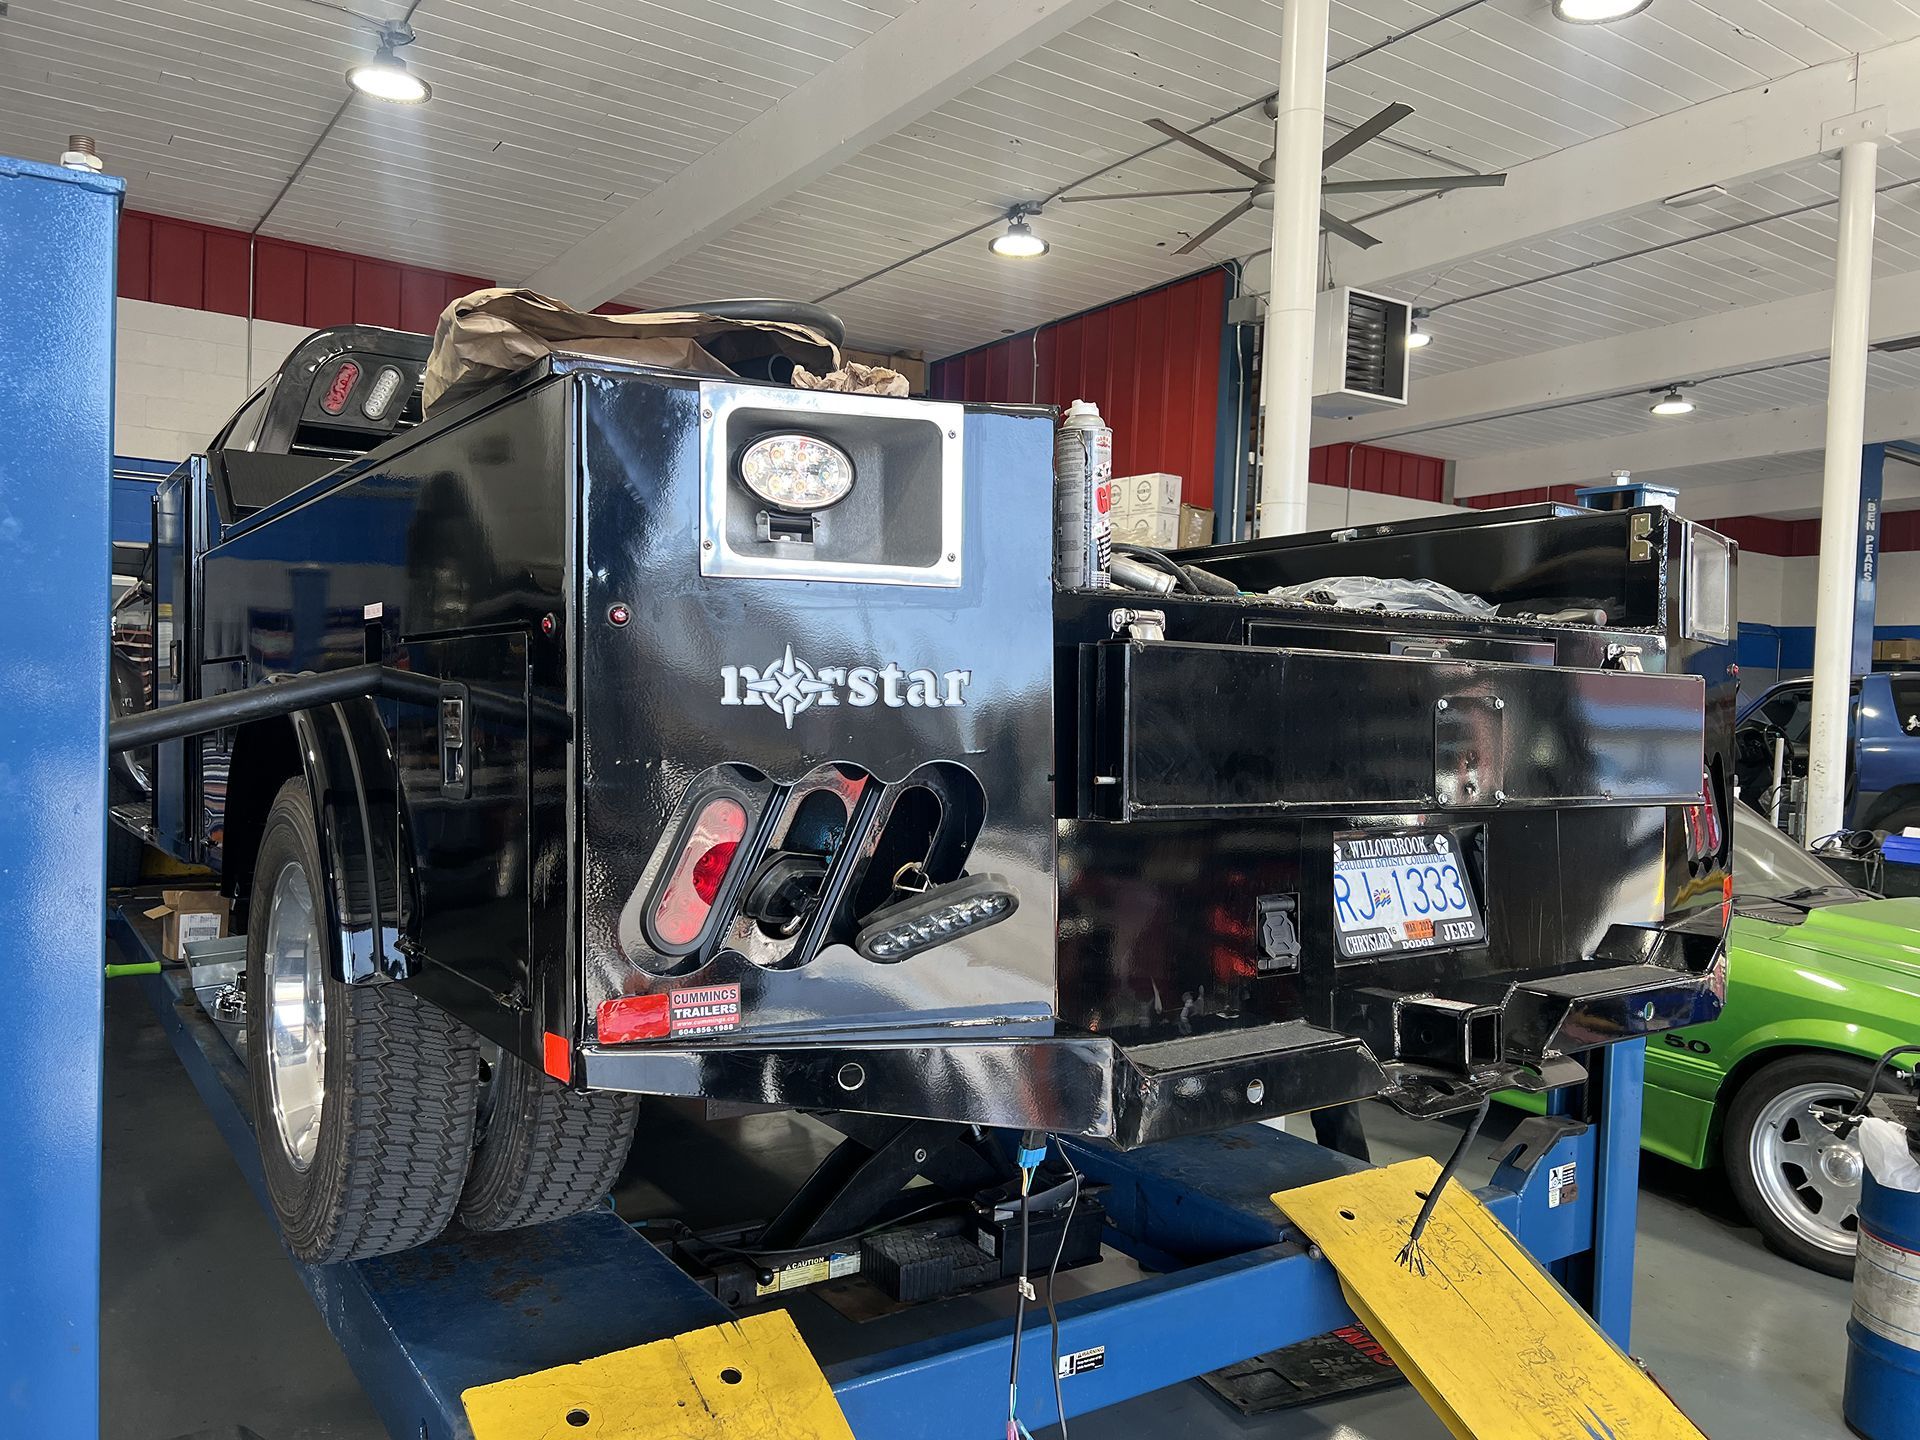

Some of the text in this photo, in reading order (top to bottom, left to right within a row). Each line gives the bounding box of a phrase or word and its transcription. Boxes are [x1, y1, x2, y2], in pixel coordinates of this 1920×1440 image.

[1863, 503, 1876, 599] BEN PEARS
[720, 642, 972, 729] norstar
[1348, 837, 1428, 858] WILLOWBROOK
[1334, 865, 1467, 923] RJ 1333
[1442, 921, 1476, 941] JEEP
[1345, 932, 1392, 954] CHRYSLER
[1401, 937, 1435, 950] DODGE
[674, 989, 736, 1004] CUMMINGS
[674, 1004, 737, 1018] TRAILERS
[792, 1256, 825, 1269] CAUTION
